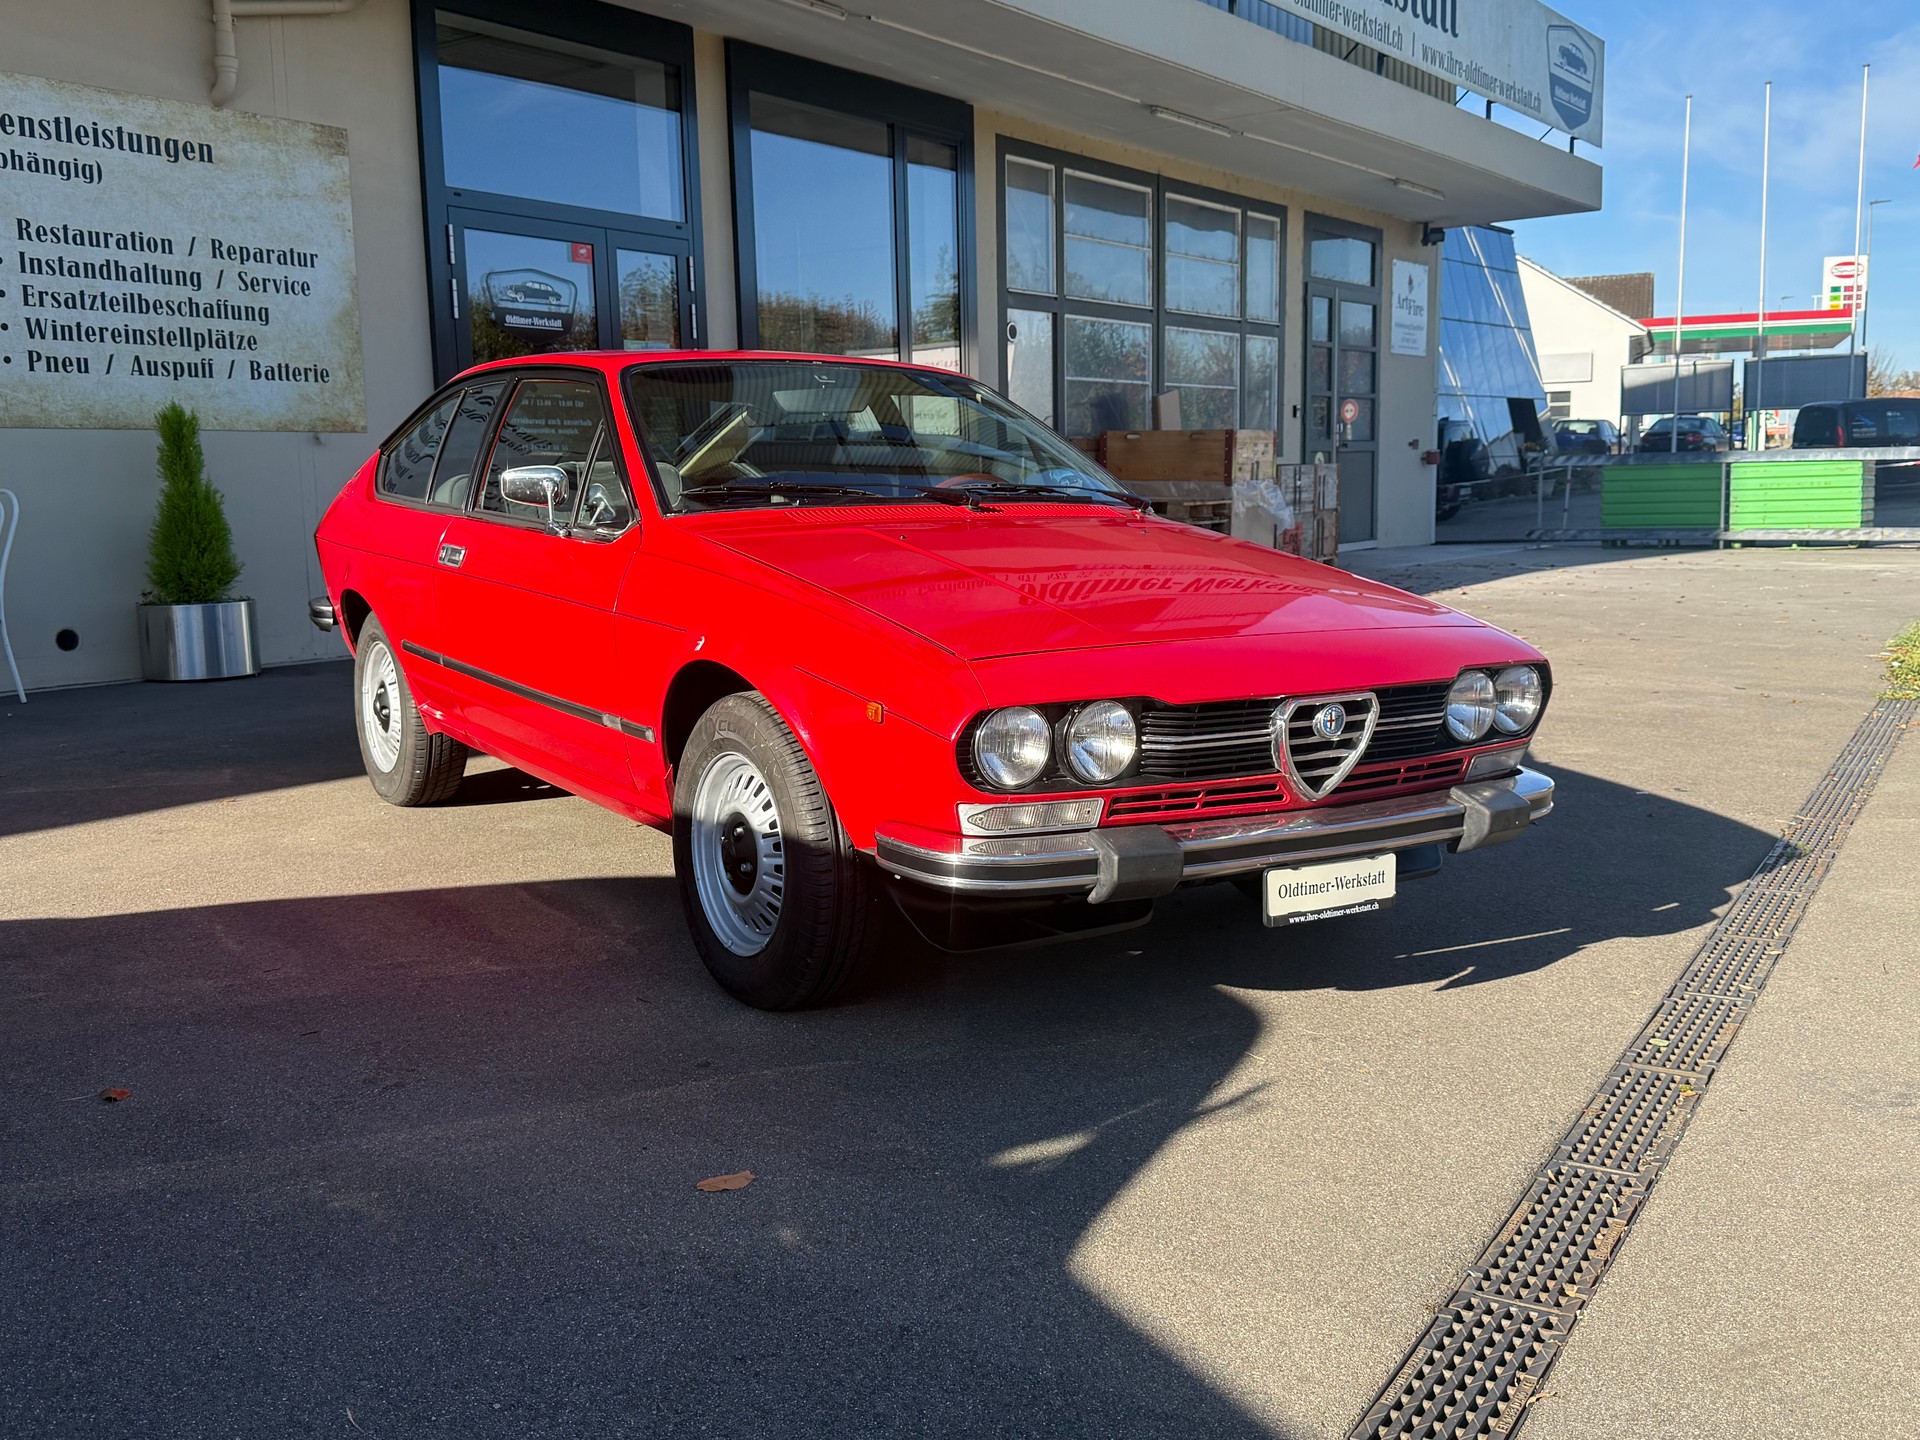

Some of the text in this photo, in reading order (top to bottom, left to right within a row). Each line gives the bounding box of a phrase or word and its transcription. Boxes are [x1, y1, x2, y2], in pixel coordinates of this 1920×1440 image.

[1421, 42, 1542, 114] www.ihre-oldtimer-werkstatt.ch
[0, 113, 214, 164] enstleistungen
[15, 218, 174, 256] Restauration
[210, 238, 319, 269] Reparatur
[18, 252, 202, 292] Instandhaltung
[238, 270, 312, 297] Service
[21, 284, 270, 326] Ersatzteilbeschaffung
[505, 314, 562, 328] Oldtimer-Werkstatt
[24, 317, 259, 352] Wintereinstellplätze
[27, 350, 90, 374] Pneu
[130, 354, 214, 381] Auspuff
[250, 360, 331, 384] Batterie
[1278, 869, 1386, 899] Oldtimer-Werkstatt
[1288, 901, 1380, 924] www.ihre-oldtimer-werkstatt.ch
